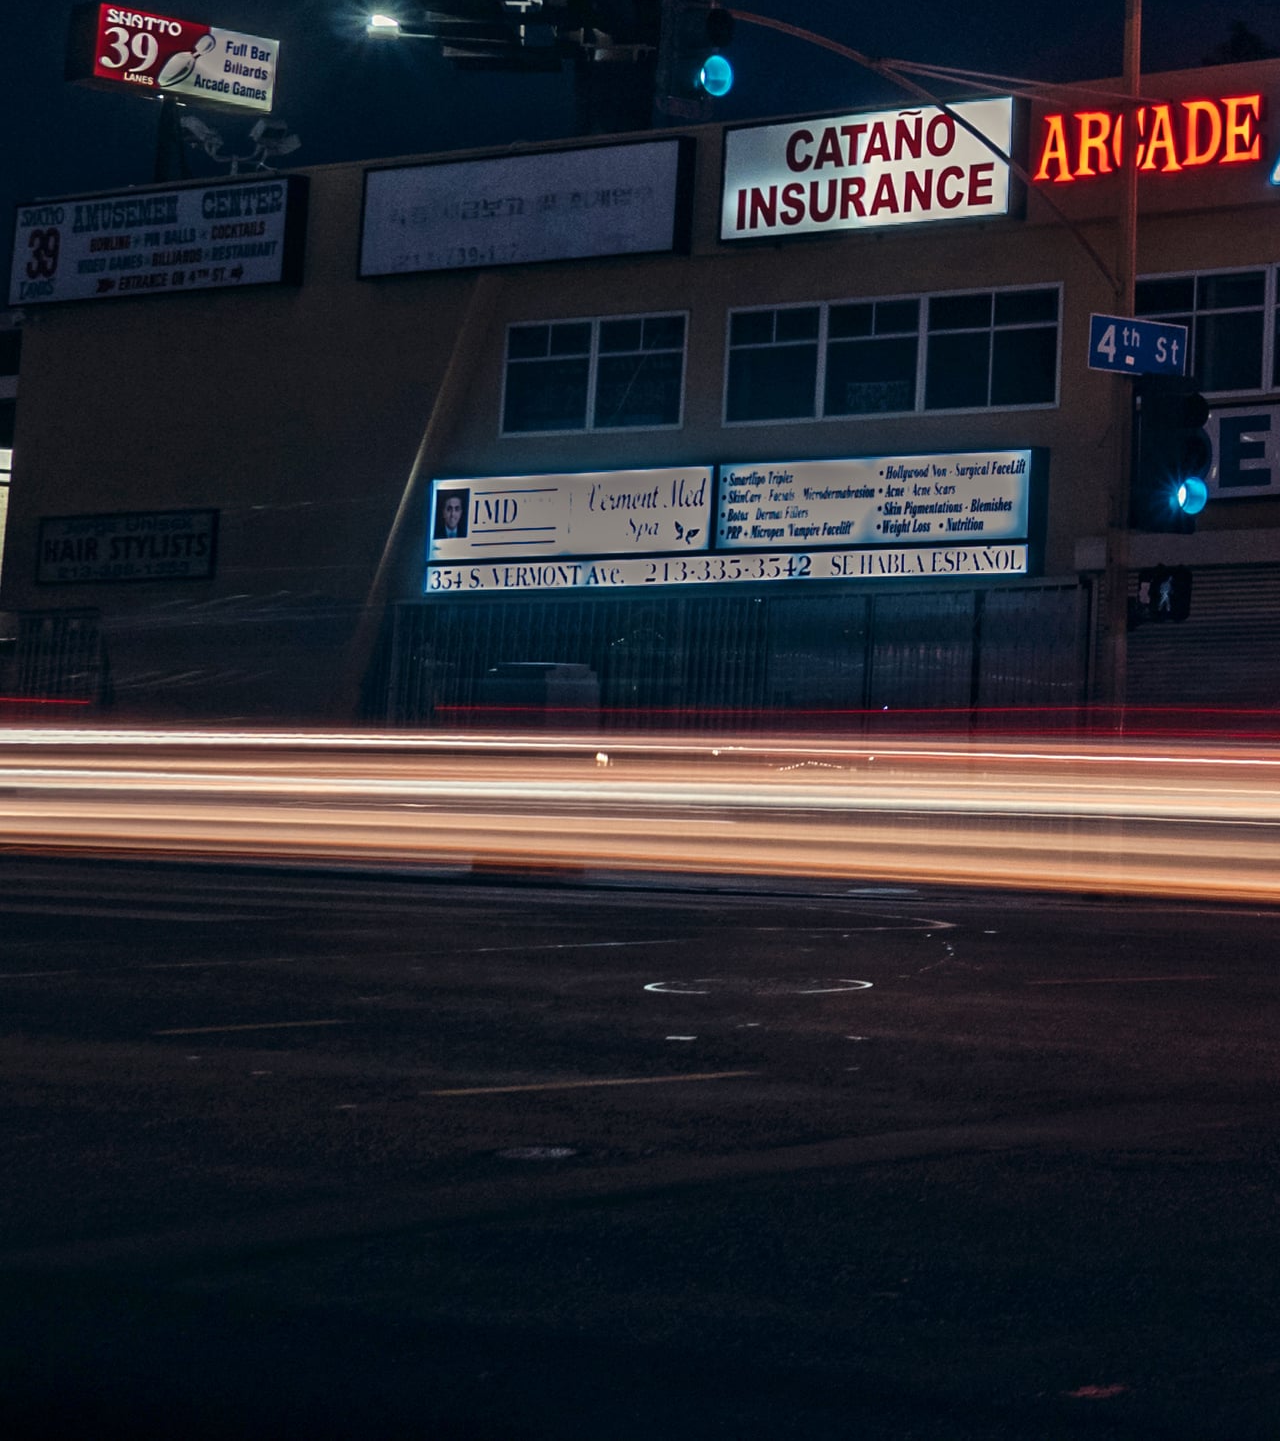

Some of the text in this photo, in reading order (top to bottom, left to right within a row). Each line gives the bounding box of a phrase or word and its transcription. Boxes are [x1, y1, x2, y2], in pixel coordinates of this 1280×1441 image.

[106, 9, 182, 36] SHATTO
[99, 27, 158, 72] 39
[226, 41, 271, 62] Full Bar
[124, 72, 154, 85] LANES
[194, 75, 267, 101] Arcade Games
[785, 109, 957, 173] CATAÑO
[202, 184, 283, 219] CENTER
[736, 161, 996, 231] INSURANCE
[211, 220, 266, 240] COCKTAILS
[26, 227, 60, 279] 39
[212, 240, 277, 261] RESTAURANT
[118, 273, 167, 291] ENTRANCE
[1097, 324, 1179, 365] 4th St
[886, 464, 930, 483] Hollywood
[955, 461, 989, 480] Surgical
[991, 458, 1026, 475] FaceLift
[885, 484, 905, 498] Acne
[934, 482, 956, 496] Scars
[883, 497, 1013, 518] Skin Pigmentations Blemishes
[726, 525, 743, 540] PRP
[882, 517, 984, 537] Weight Loss Nutrition
[44, 532, 208, 564] HAIR STYLISTS
[468, 568, 484, 589] S.
[492, 564, 582, 587] VERMONT
[860, 552, 924, 575] HABLA
[932, 546, 1022, 573] ESPAÑOL
